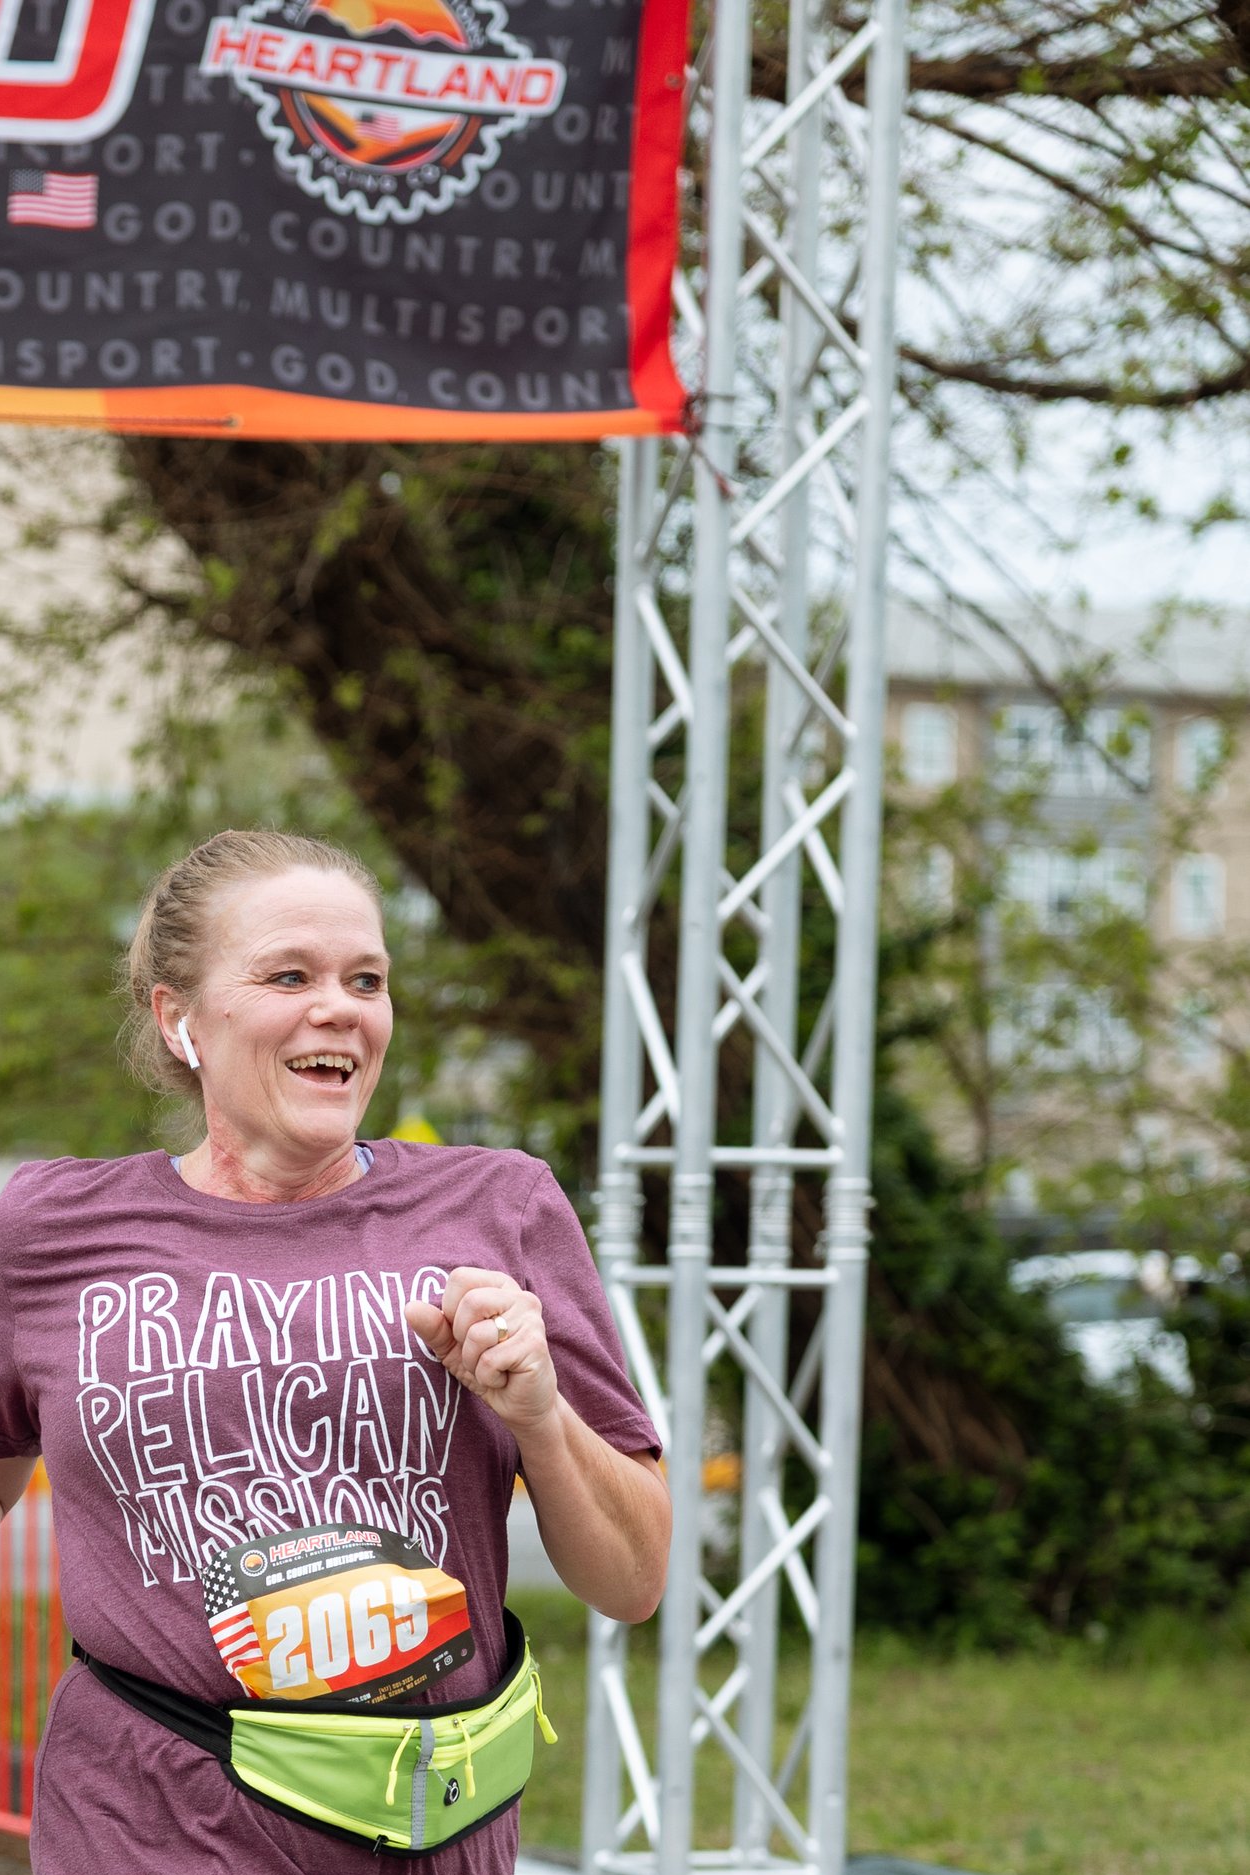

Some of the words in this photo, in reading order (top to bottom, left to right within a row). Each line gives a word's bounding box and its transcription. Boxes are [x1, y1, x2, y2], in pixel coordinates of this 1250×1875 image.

[208, 25, 558, 108] HEARTLAND
[76, 1358, 462, 1497] PELICAN
[268, 1530, 382, 1563] HEARTLAND
[286, 1561, 325, 1581] COUNTRY.
[326, 1550, 376, 1569] MULTISPORT.
